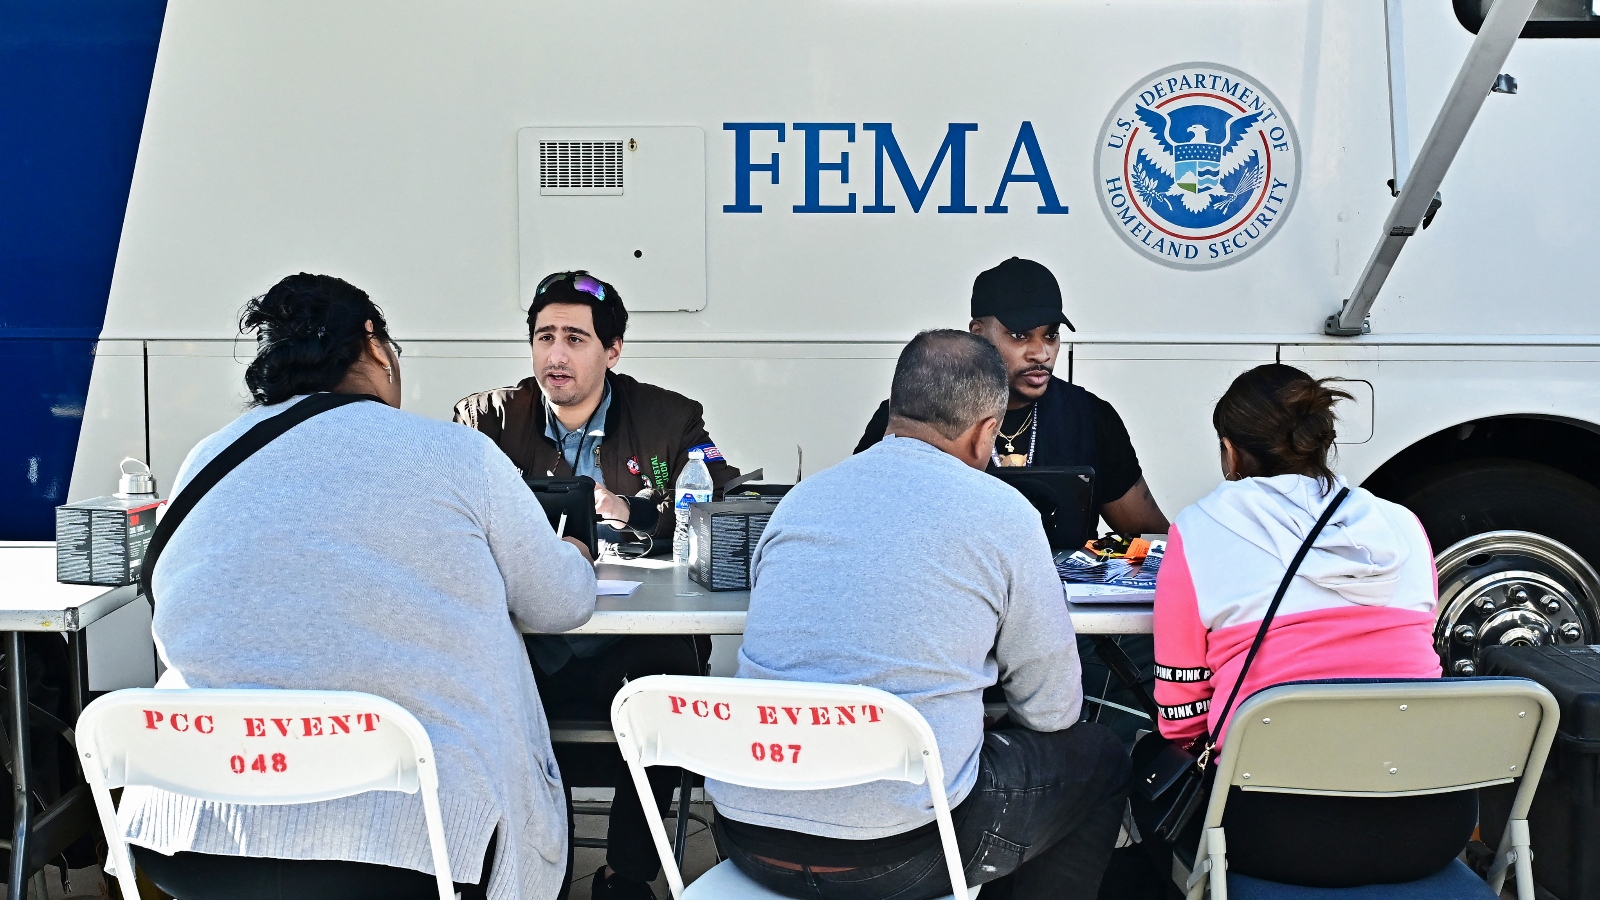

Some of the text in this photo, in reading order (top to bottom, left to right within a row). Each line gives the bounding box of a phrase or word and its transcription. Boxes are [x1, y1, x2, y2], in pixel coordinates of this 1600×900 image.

[1107, 73, 1290, 152] U.S. DEPARTMENT OF
[722, 120, 1069, 214] FEMA
[1105, 176, 1288, 259] HOMELAND SECURITY
[651, 455, 665, 489] CRYSTAL
[1156, 665, 1173, 680] PINK
[1175, 669, 1201, 681] PINK
[142, 709, 381, 737] PCC EVENT
[668, 695, 884, 726] PCC EVENT
[1167, 704, 1194, 719] PINK
[230, 752, 288, 774] 048
[751, 742, 802, 764] 087
